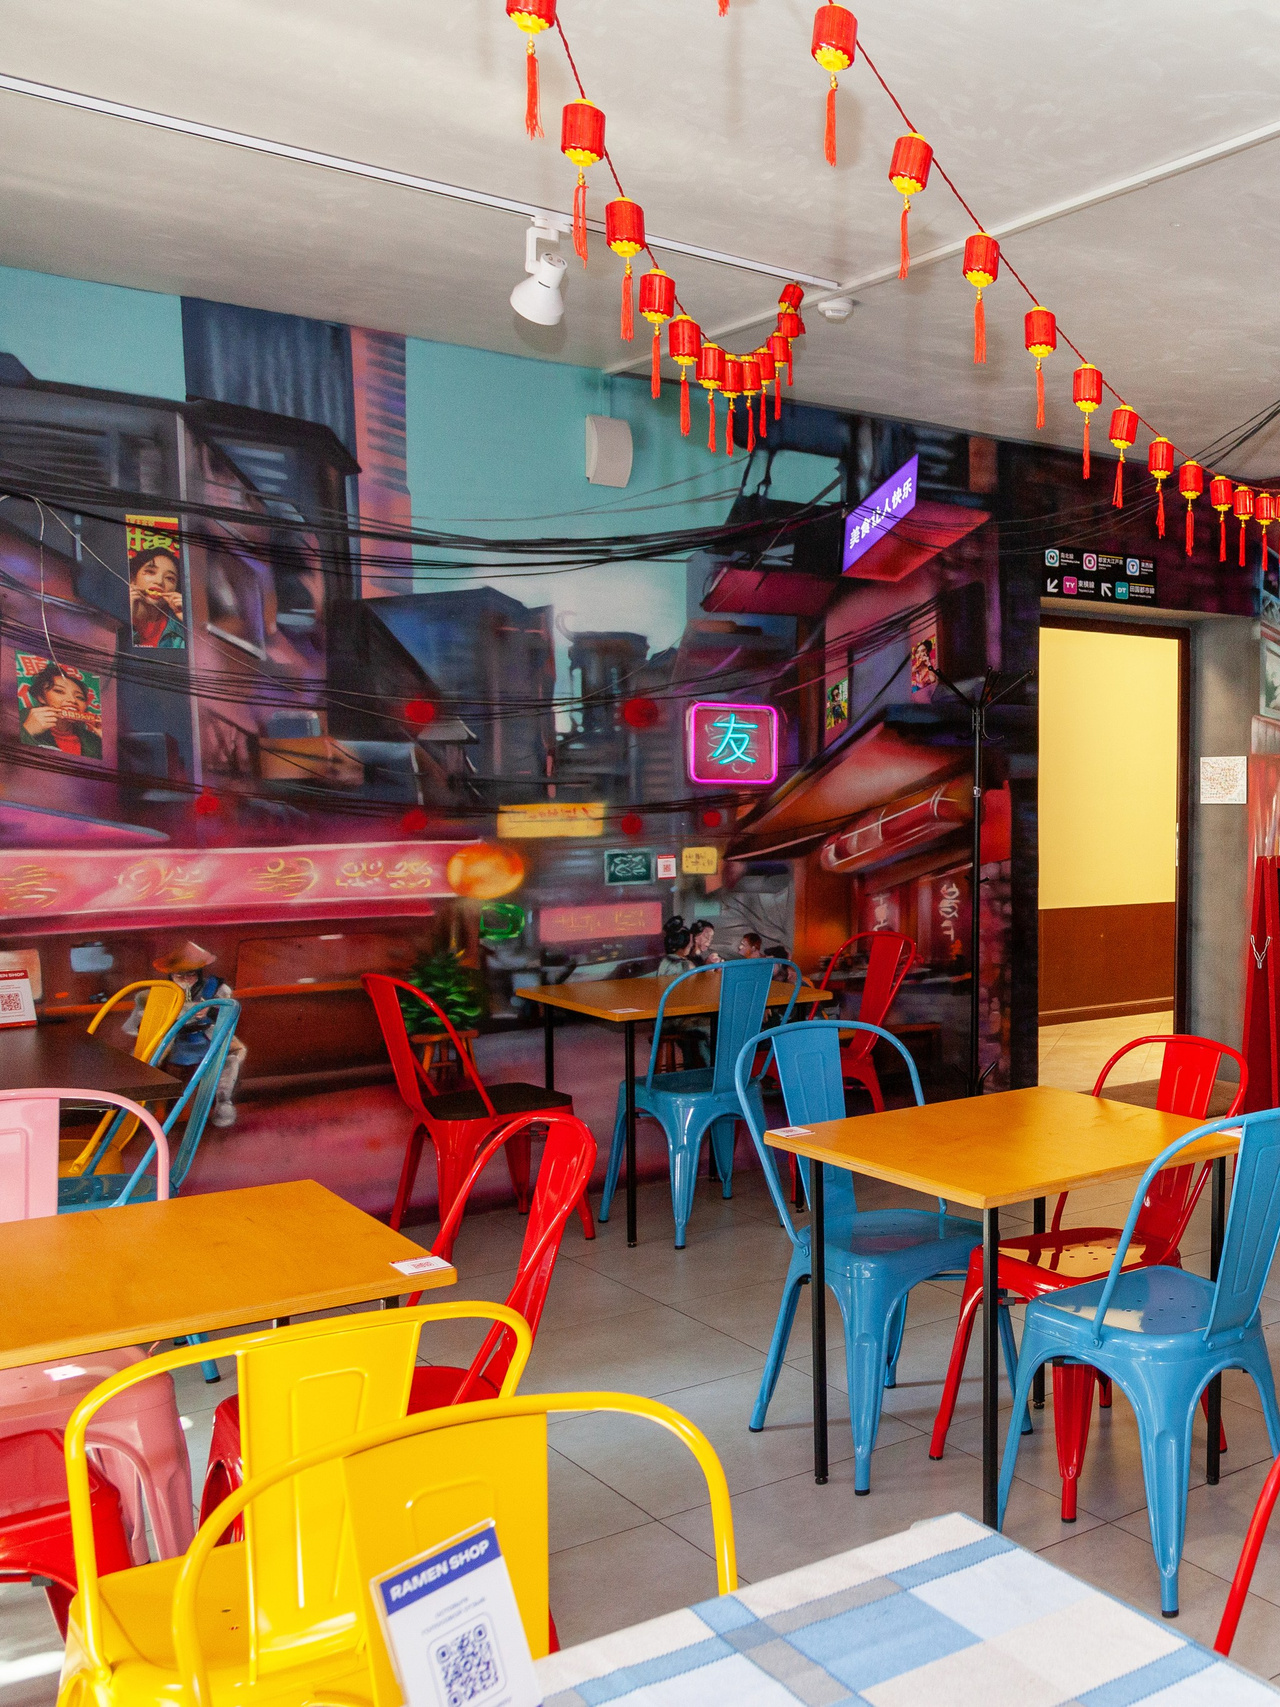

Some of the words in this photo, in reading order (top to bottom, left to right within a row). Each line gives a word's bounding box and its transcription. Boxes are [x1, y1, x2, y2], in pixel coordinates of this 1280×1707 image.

[712, 713, 759, 766] 友
[389, 1559, 450, 1602] RAMEN
[449, 1539, 490, 1571] SHOP
